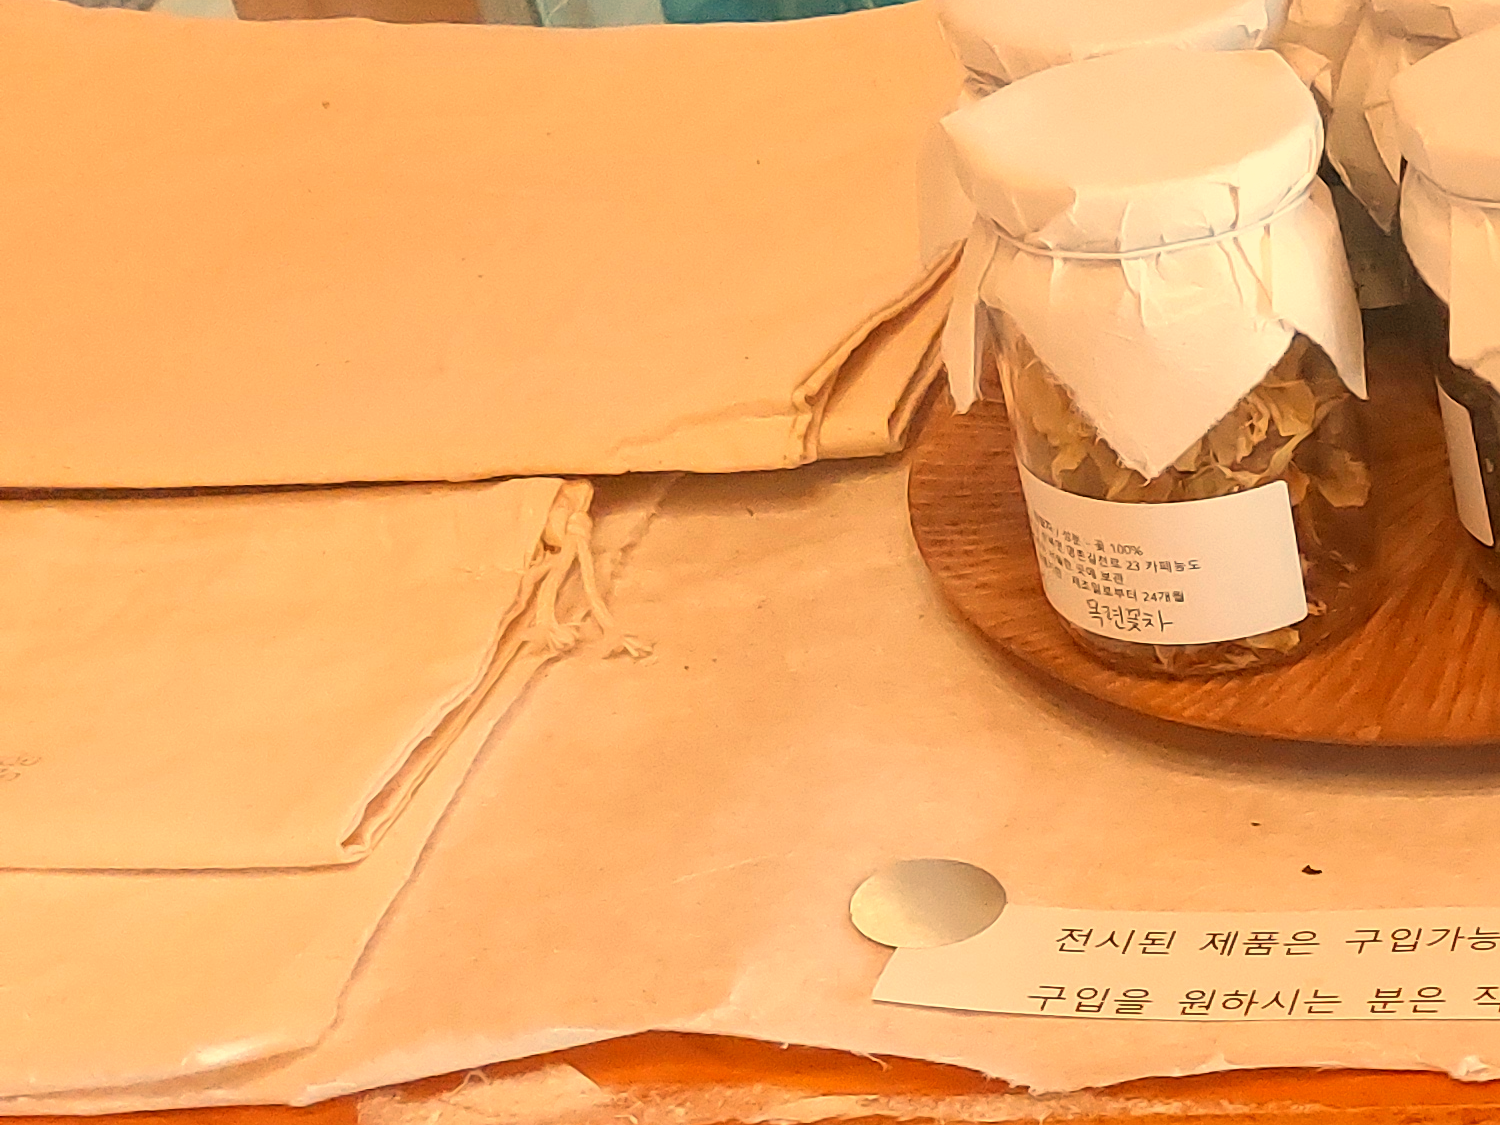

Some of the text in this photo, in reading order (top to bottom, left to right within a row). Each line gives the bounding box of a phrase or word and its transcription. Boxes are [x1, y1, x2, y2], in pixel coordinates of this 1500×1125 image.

[1110, 544, 1144, 557] 100%
[1101, 572, 1124, 586] 보관
[1126, 560, 1141, 572] 23
[1072, 576, 1185, 603] 제조일로부터 24개월
[1086, 598, 1173, 633] 목련꽃차
[1055, 926, 1178, 956] 전시된
[1198, 928, 1322, 958] 제품은
[1026, 984, 1154, 1014] 구입을
[1177, 987, 1343, 1017] 원하시는
[1366, 986, 1447, 1014] 분은
